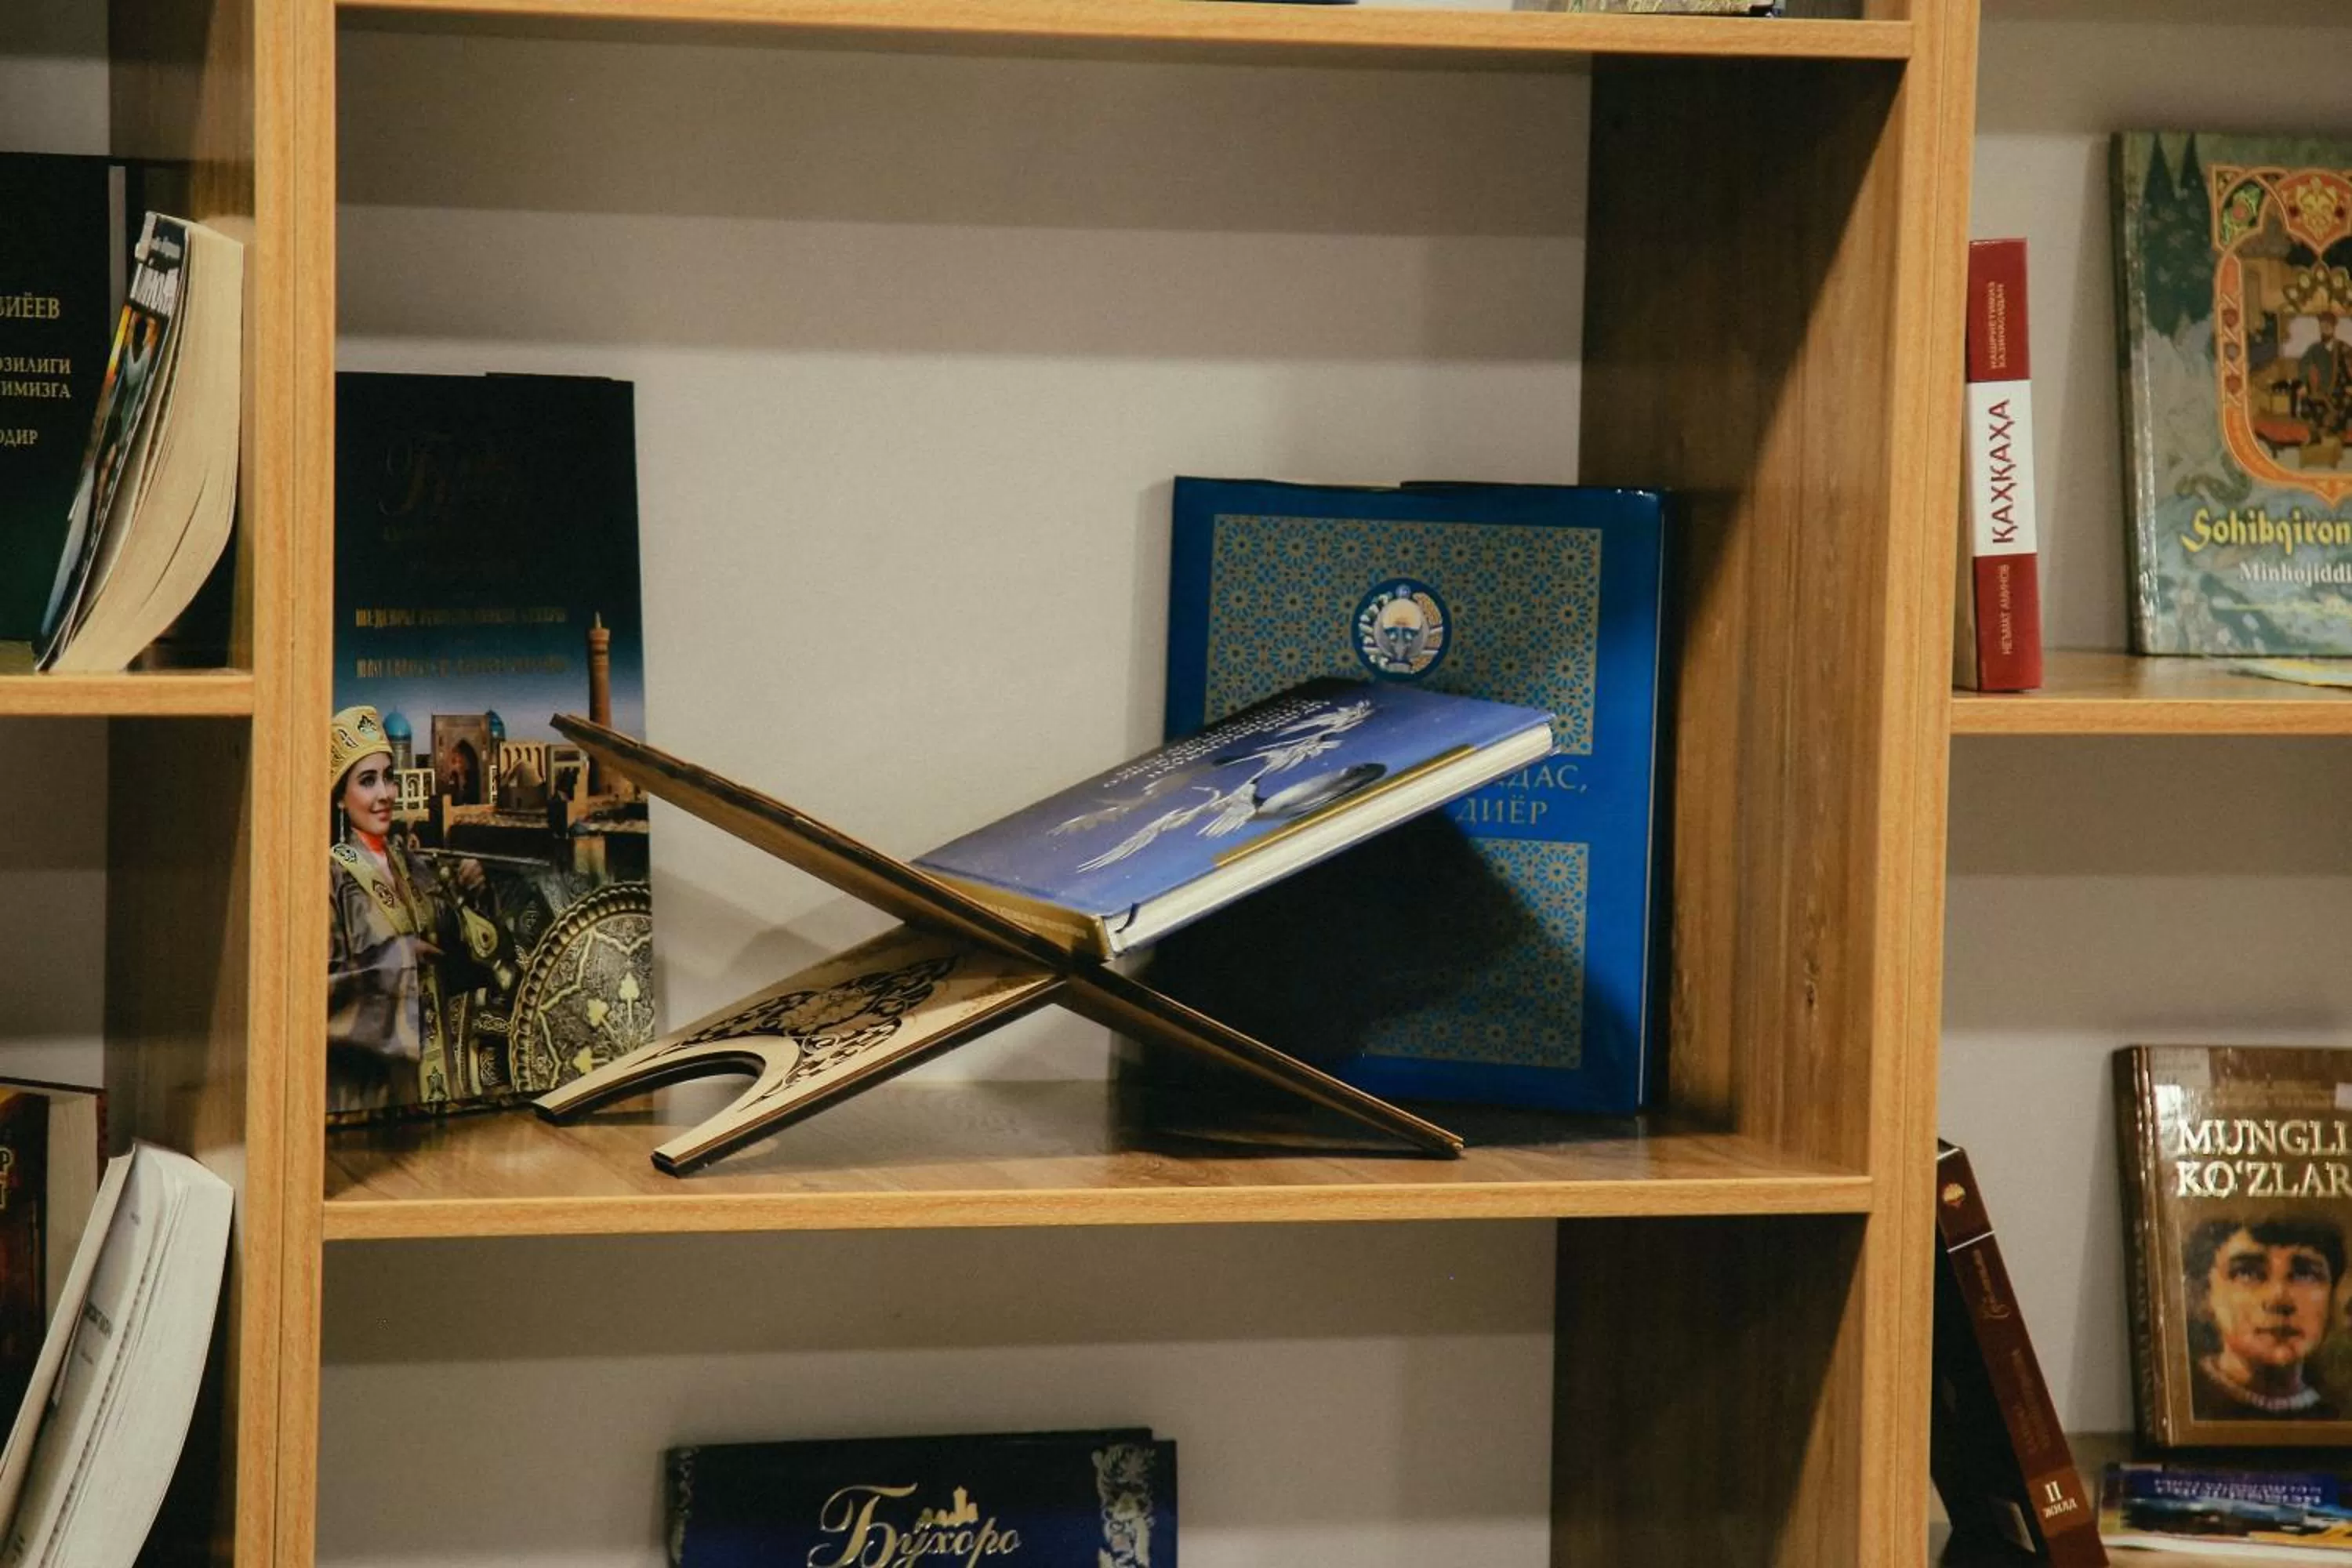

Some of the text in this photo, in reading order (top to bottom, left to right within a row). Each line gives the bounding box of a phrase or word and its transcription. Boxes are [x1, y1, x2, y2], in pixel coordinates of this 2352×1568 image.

[0, 380, 72, 398] ИМИЗГА
[2181, 508, 2350, 555] Sohibqiron
[1498, 764, 1588, 793] ДАС,
[1455, 793, 1548, 826] ДИЁР
[2176, 1119, 2352, 1156] MUNGLI
